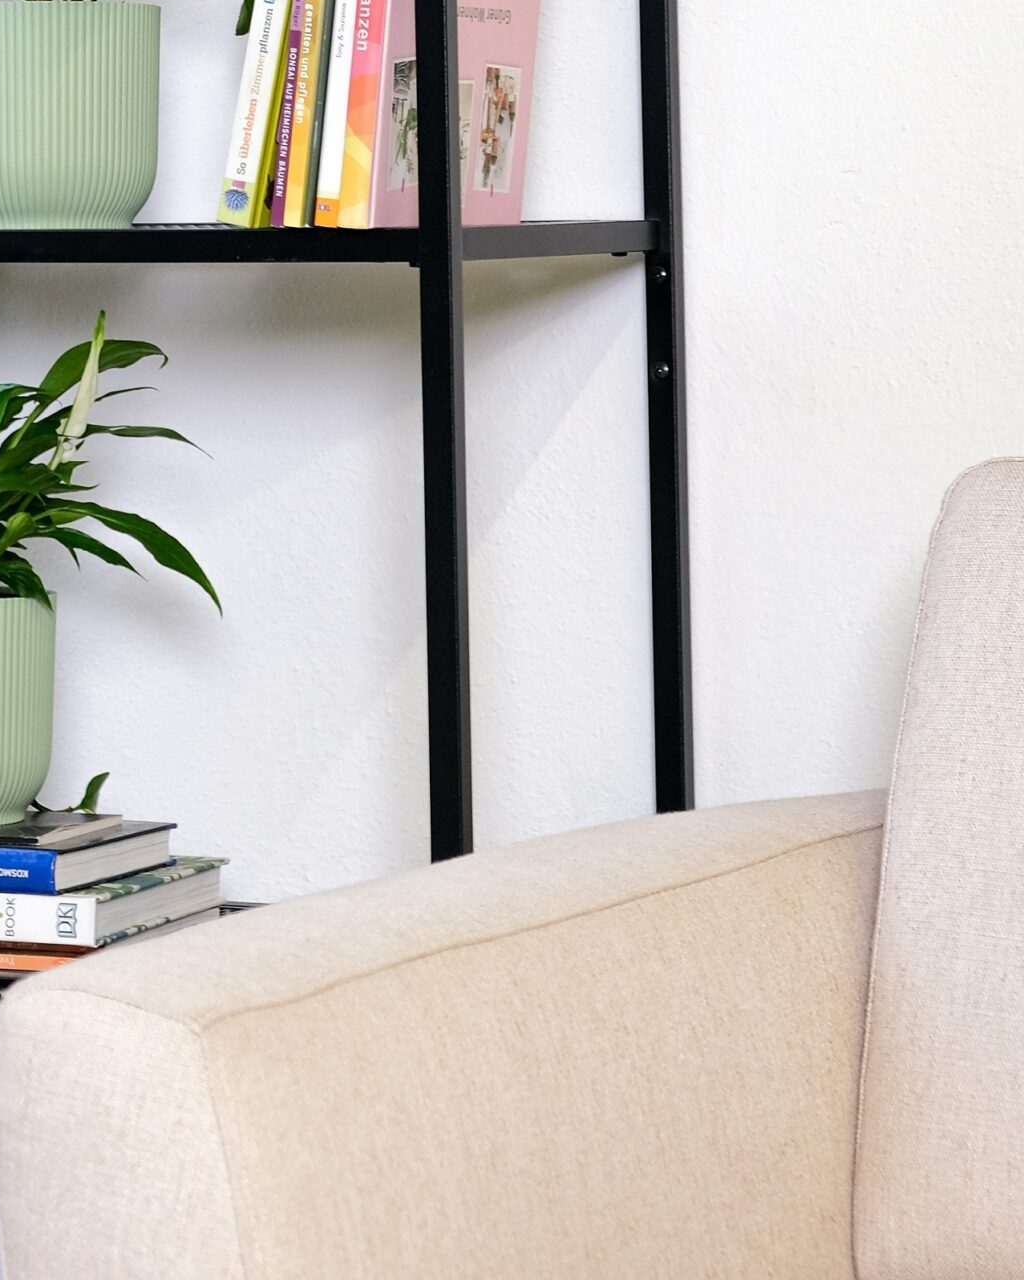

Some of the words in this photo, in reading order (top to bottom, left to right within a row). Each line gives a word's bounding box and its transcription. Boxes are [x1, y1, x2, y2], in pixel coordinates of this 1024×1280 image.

[302, 4, 314, 54] gestalten
[250, 8, 274, 95] Zimmerpflanzen
[287, 47, 298, 80] BONSAI
[299, 58, 309, 79] und
[336, 42, 345, 59] Tony
[285, 82, 294, 101] AUS
[294, 82, 308, 125] pflegen
[238, 98, 258, 159] überleben
[279, 102, 292, 157] HEIMISCHEN
[236, 162, 247, 176] So
[4, 897, 16, 937] BOOK
[57, 903, 77, 938] DK
